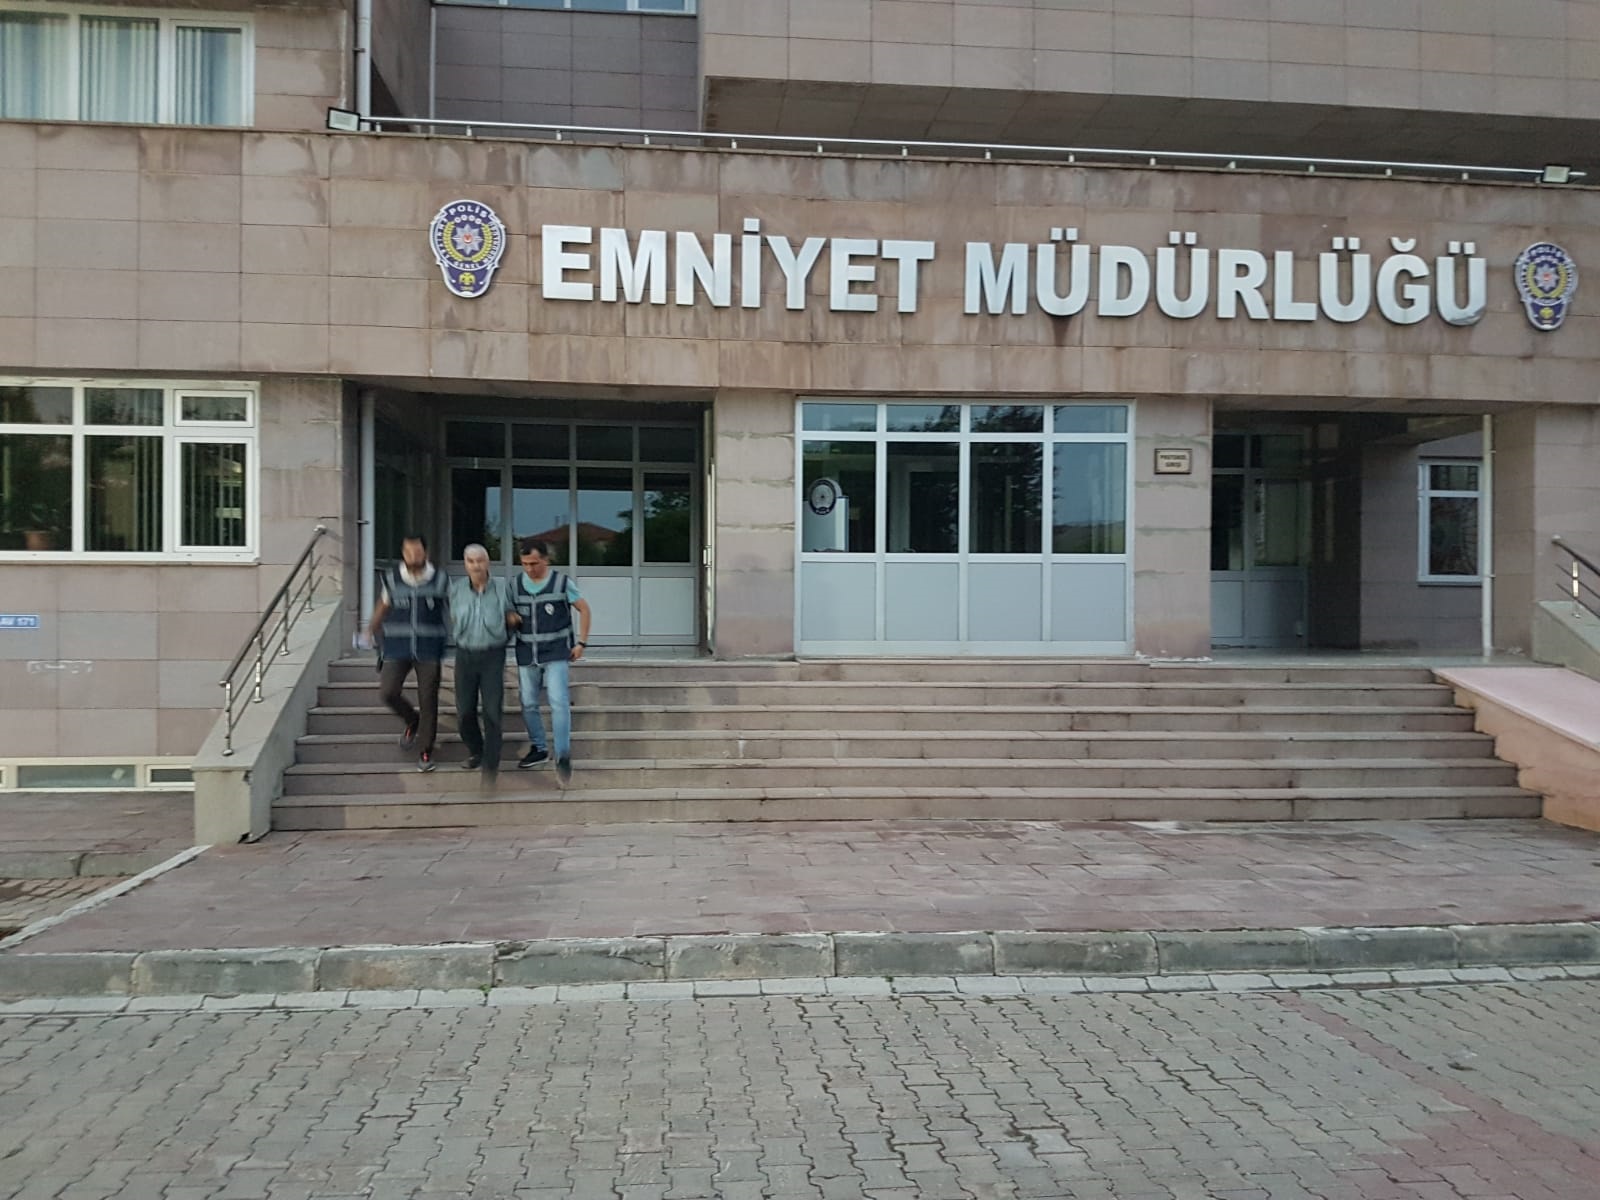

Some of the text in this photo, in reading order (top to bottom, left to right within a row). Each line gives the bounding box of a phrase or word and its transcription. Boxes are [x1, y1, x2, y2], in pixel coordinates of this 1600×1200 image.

[449, 204, 488, 218] POLİS
[542, 218, 935, 313] EMNİYET
[965, 227, 1487, 325] MÜDÜRLÜĞÜ
